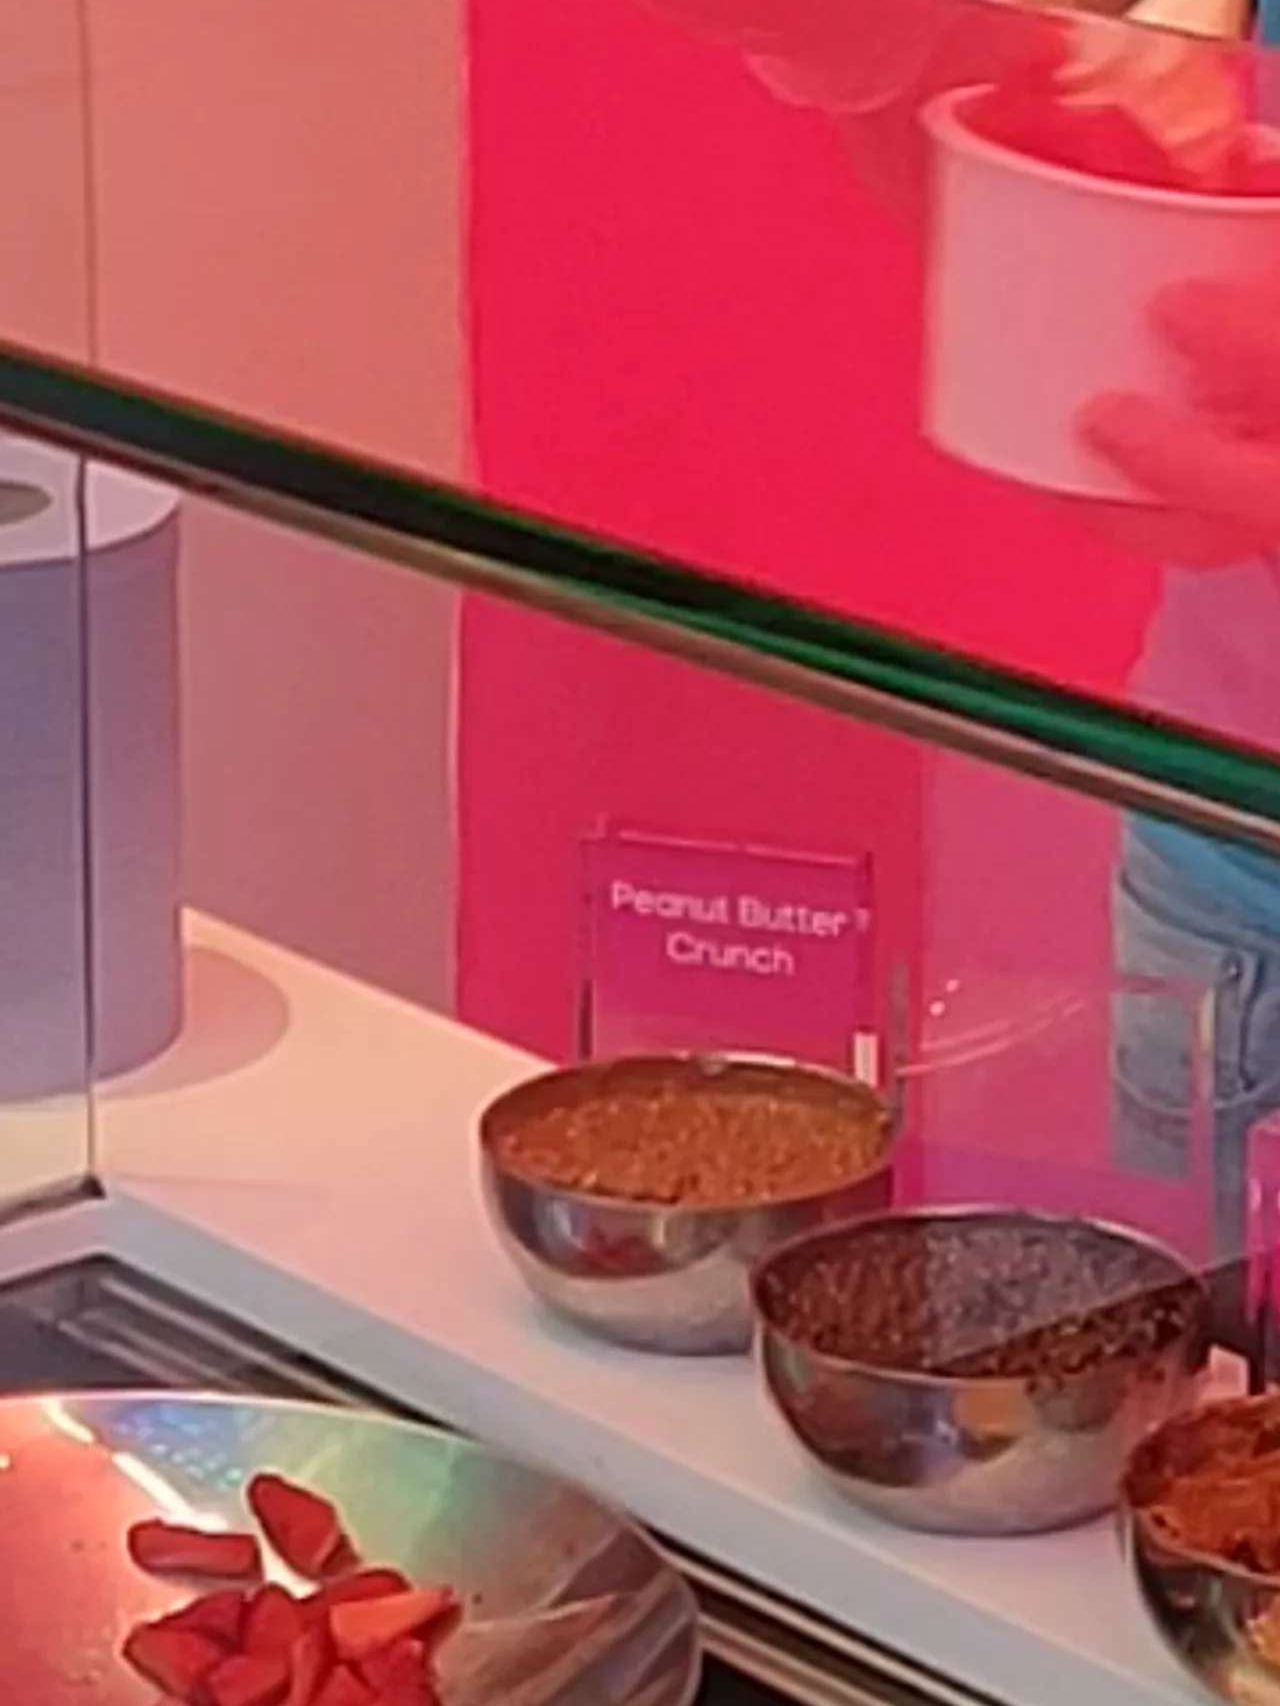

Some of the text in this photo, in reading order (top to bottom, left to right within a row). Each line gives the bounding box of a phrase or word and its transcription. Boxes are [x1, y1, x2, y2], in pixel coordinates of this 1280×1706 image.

[611, 880, 847, 936] Peanut Butter
[666, 932, 795, 976] Crunch
